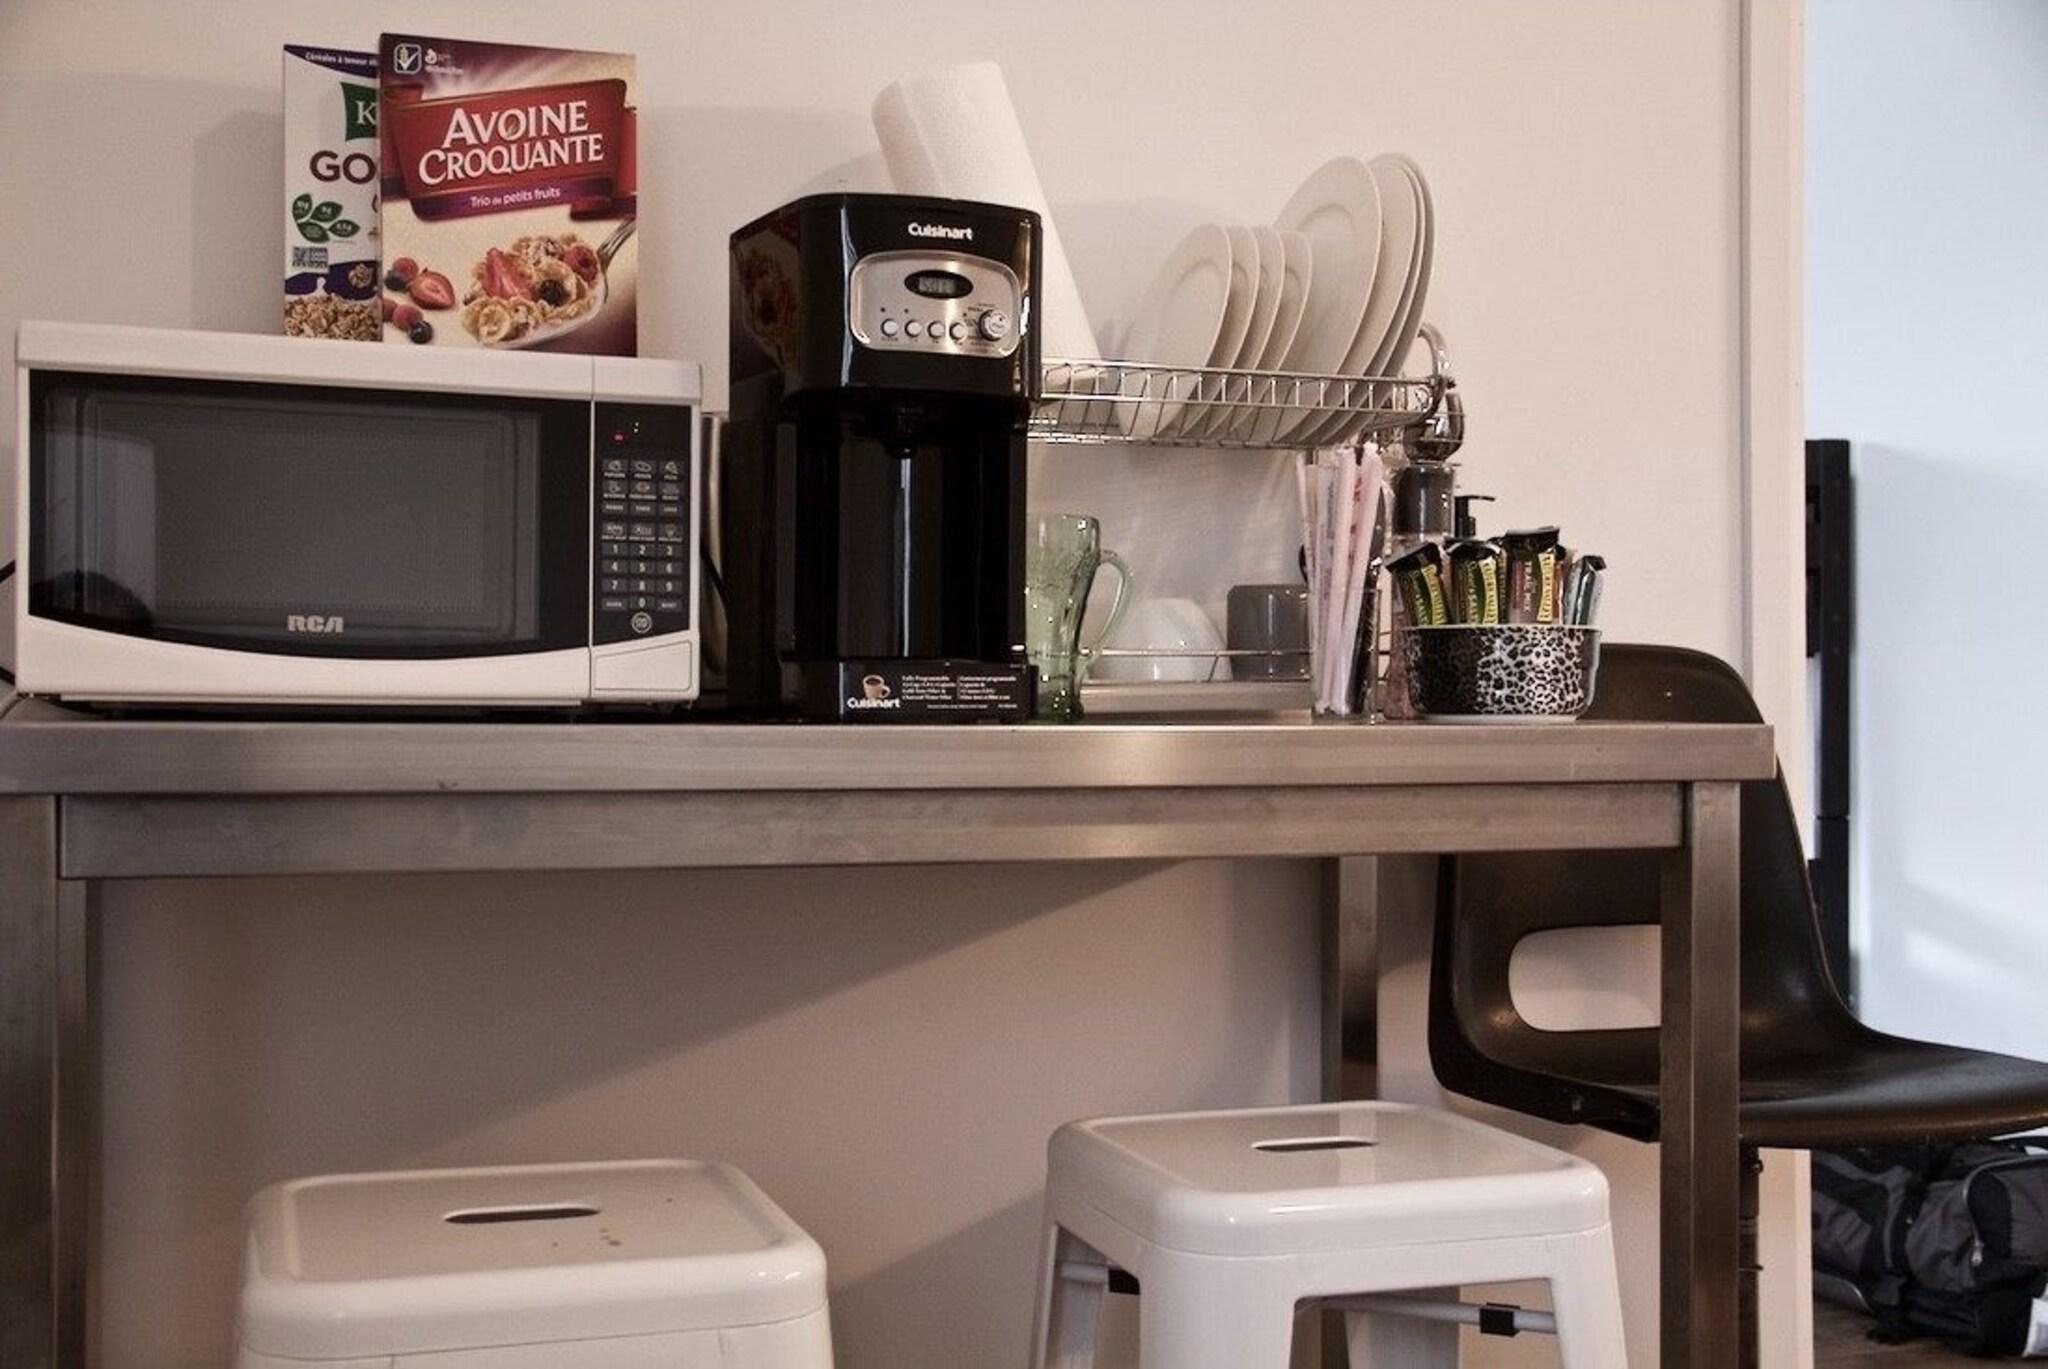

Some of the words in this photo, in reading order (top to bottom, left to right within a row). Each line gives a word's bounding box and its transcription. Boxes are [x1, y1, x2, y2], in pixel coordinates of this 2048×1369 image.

[442, 99, 589, 150] AVOINE
[419, 134, 605, 186] CROQUANTE
[470, 195, 491, 208] Trio
[503, 190, 533, 206] petits
[534, 186, 561, 200] fruits
[907, 222, 974, 241] Cuisinart
[287, 614, 345, 633] RCA
[847, 697, 901, 710] Cuisinart
